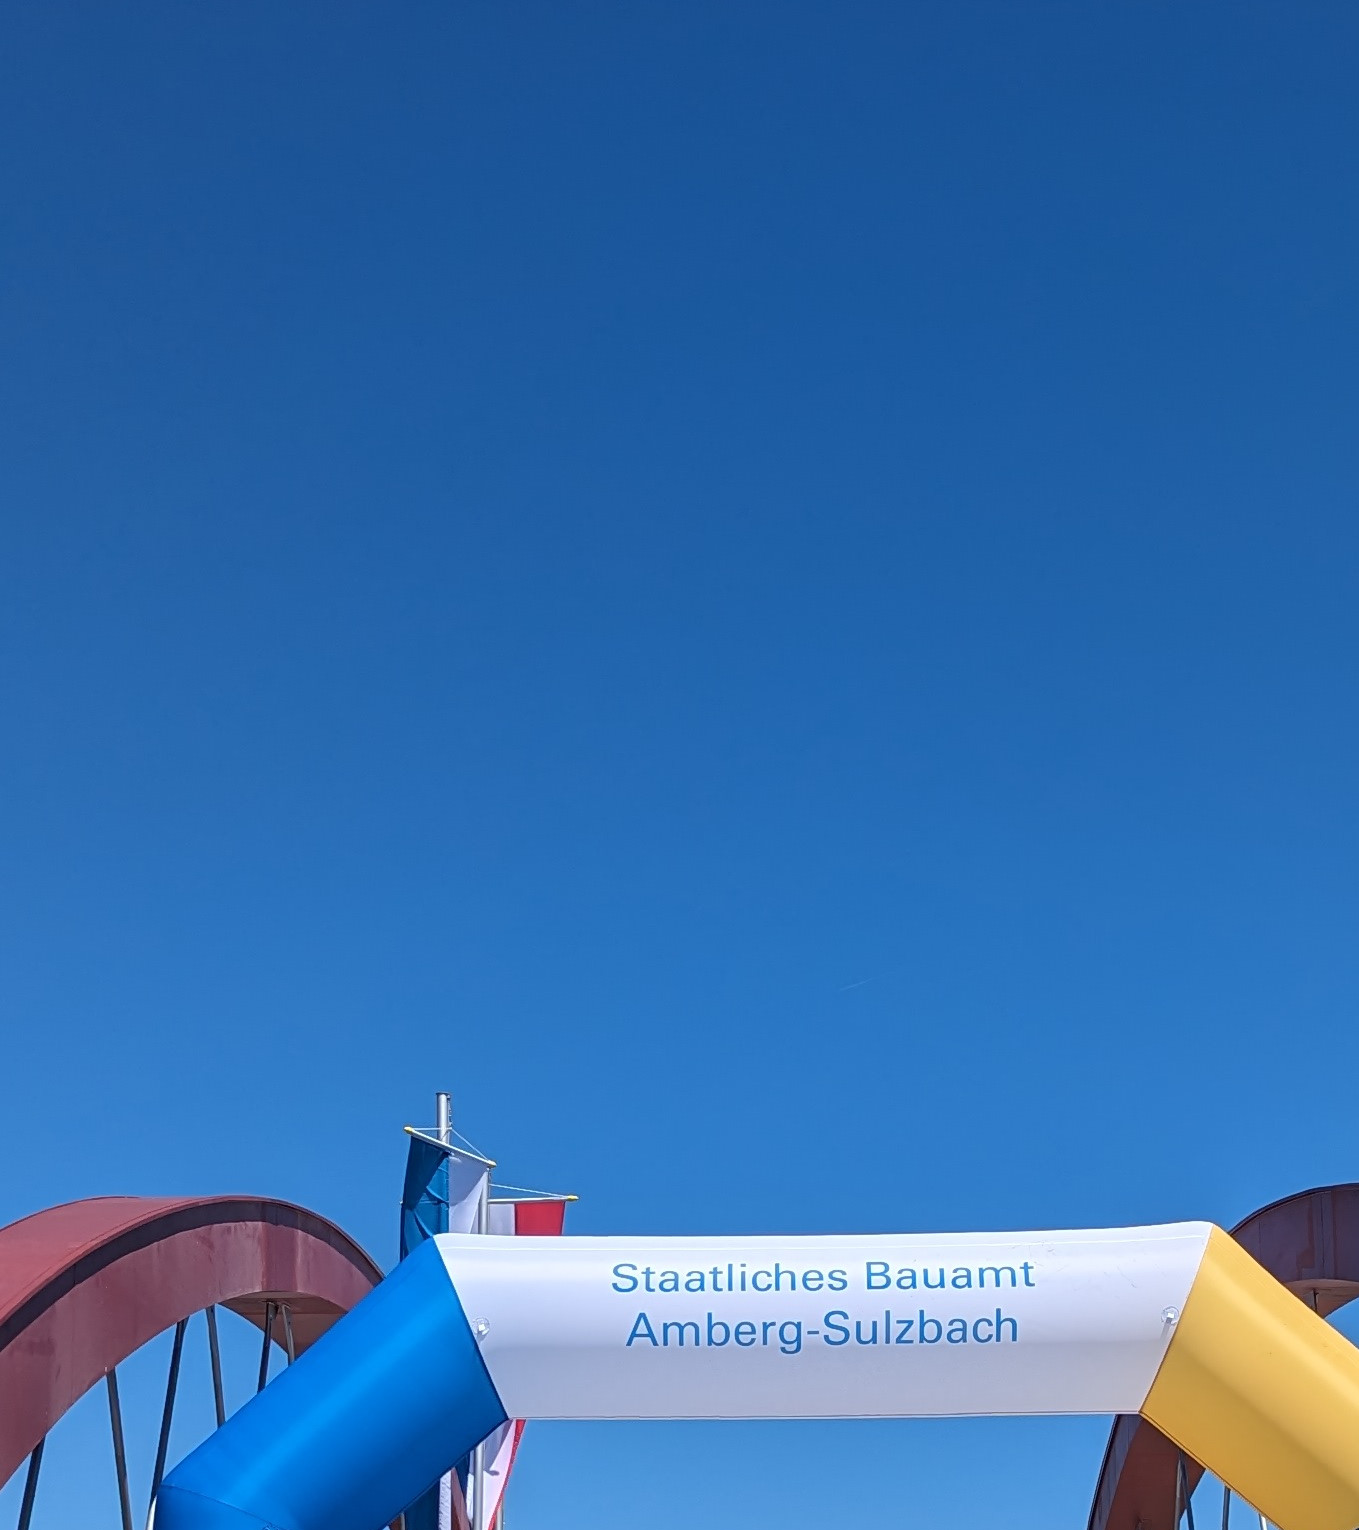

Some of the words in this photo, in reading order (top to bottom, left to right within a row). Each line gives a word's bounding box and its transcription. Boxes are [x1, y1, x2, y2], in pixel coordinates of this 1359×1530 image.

[611, 1262, 848, 1293] Staatliches
[865, 1260, 1036, 1290] Bauamt
[625, 1307, 1019, 1355] Amberg-Sulzbach
